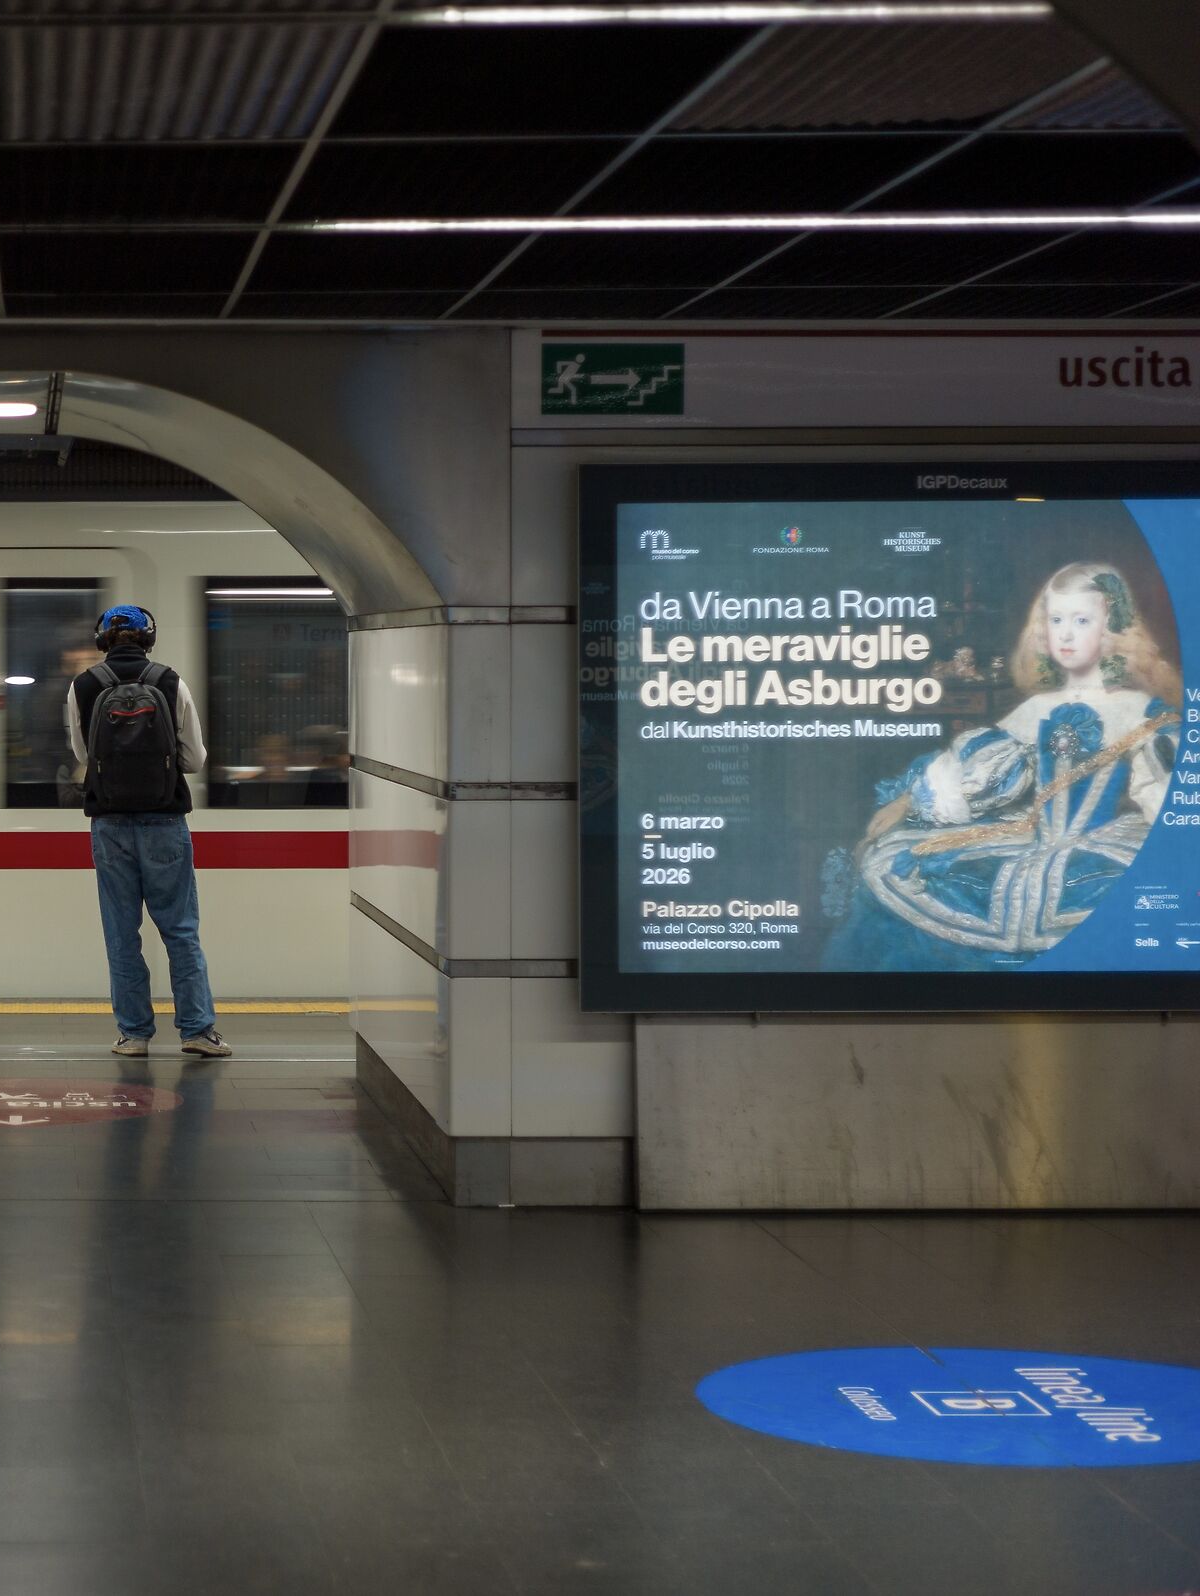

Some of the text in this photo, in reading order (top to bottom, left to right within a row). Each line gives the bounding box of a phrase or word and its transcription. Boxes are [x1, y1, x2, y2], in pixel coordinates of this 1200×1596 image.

[1058, 345, 1192, 388] uscita
[916, 474, 1008, 489] IGPDecaux
[898, 531, 926, 539] KUNST
[640, 590, 937, 621] da Vienna a Roma
[641, 625, 930, 668] Le meraviglie
[640, 669, 942, 714] degli Asburgo
[1187, 708, 1200, 723] B
[641, 720, 941, 739] dal Kunsthistorisches Museum
[1187, 729, 1200, 743] C
[1181, 750, 1200, 764] Ar
[642, 813, 655, 830] 6
[660, 816, 725, 830] marzo
[1163, 811, 1200, 826] Cara
[642, 843, 716, 864] 5 luglio
[642, 868, 691, 885] 2026
[643, 900, 799, 921] Palazzo Cipolla
[642, 922, 799, 937] via del Corso 320, Roma
[642, 938, 781, 951] museodelcorso.com
[1135, 937, 1159, 947] Sella
[838, 1386, 897, 1421] Colosseo
[941, 1398, 1017, 1410] B
[1014, 1368, 1161, 1442] linea/line
